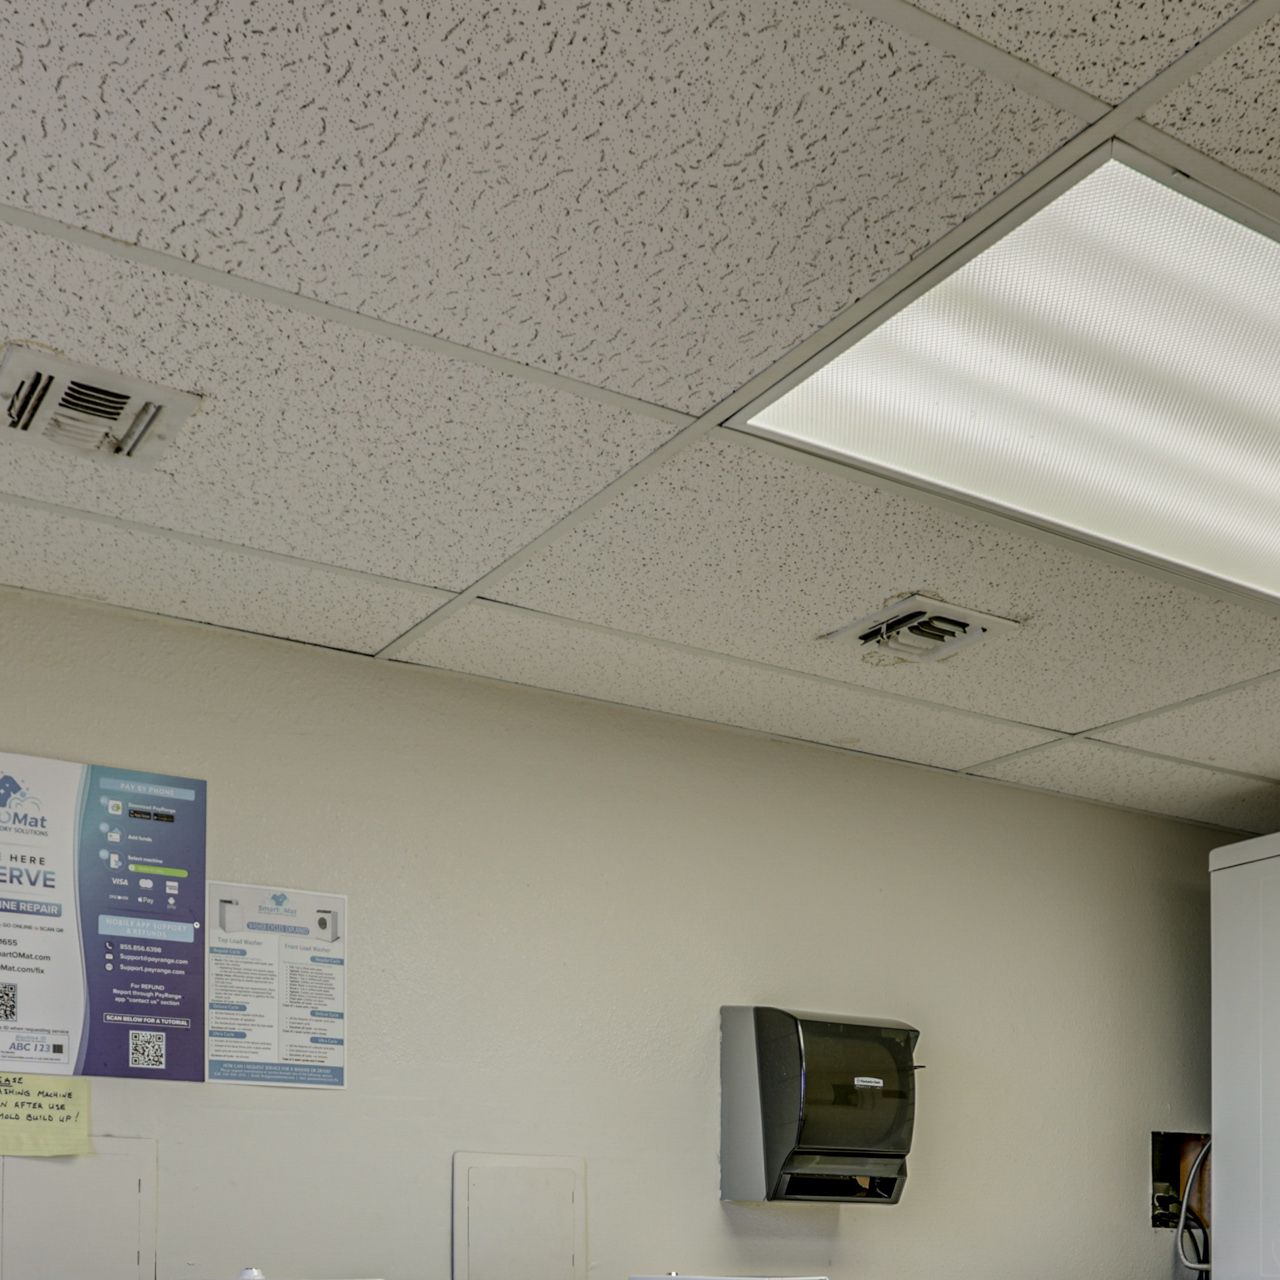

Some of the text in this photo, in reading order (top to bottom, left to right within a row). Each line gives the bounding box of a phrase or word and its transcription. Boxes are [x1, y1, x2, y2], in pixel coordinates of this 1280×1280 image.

[120, 783, 135, 791] PAY
[148, 787, 176, 796] PHONE
[14, 828, 48, 837] SOLUTIONS
[10, 854, 46, 866] HERE
[112, 877, 128, 886] VISA
[20, 902, 58, 914] REPAIR
[154, 922, 187, 933] SUPPORT
[112, 988, 132, 996] Report
[161, 1018, 188, 1026] TUTORIAL
[9, 1042, 51, 1053] ABC 123
[37, 1090, 73, 1100] MACHINE
[14, 1102, 44, 1110] AFTER
[26, 1114, 54, 1122] BUILD
